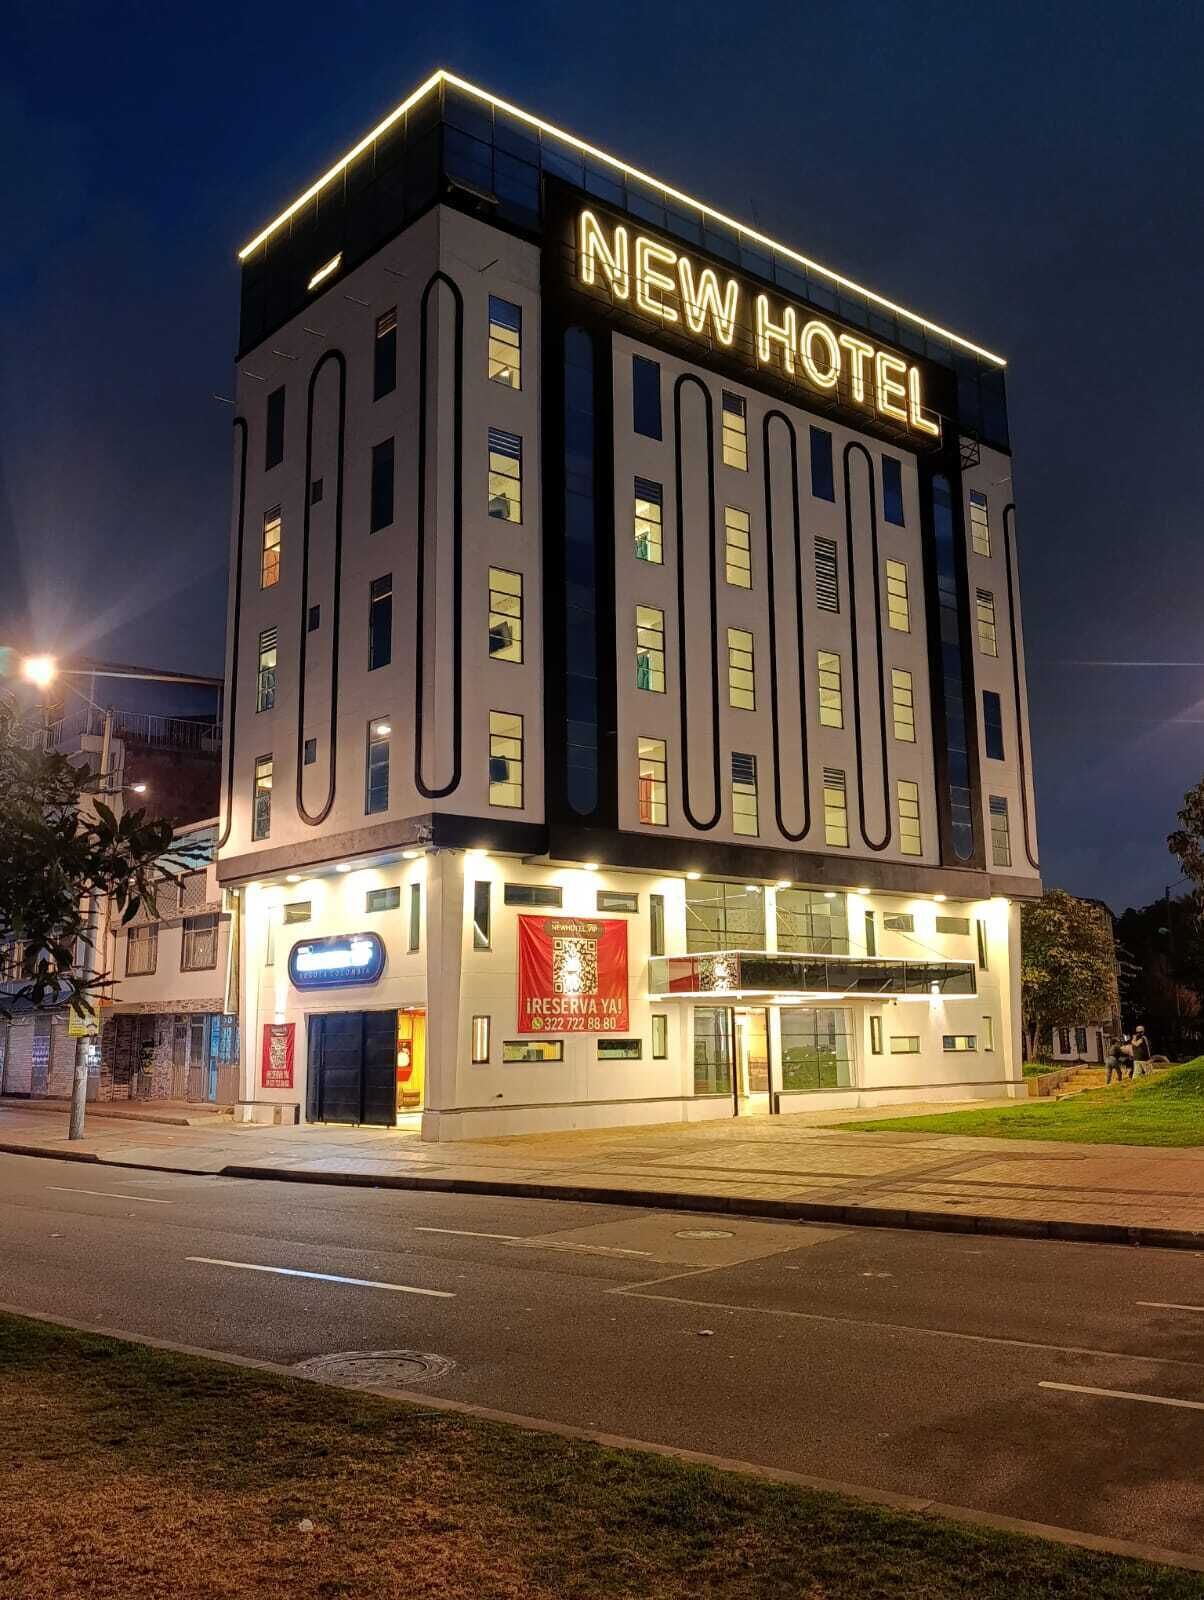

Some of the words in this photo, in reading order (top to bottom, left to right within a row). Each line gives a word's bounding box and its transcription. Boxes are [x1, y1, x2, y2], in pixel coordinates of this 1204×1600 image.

[579, 208, 739, 347] NEW
[755, 293, 941, 437] HOTEL
[526, 997, 598, 1015] ¡RESERVA
[600, 997, 623, 1014] YA!
[544, 1017, 564, 1031] 322
[566, 1017, 585, 1030] 722
[587, 1017, 601, 1030] 88
[603, 1017, 617, 1030] 80
